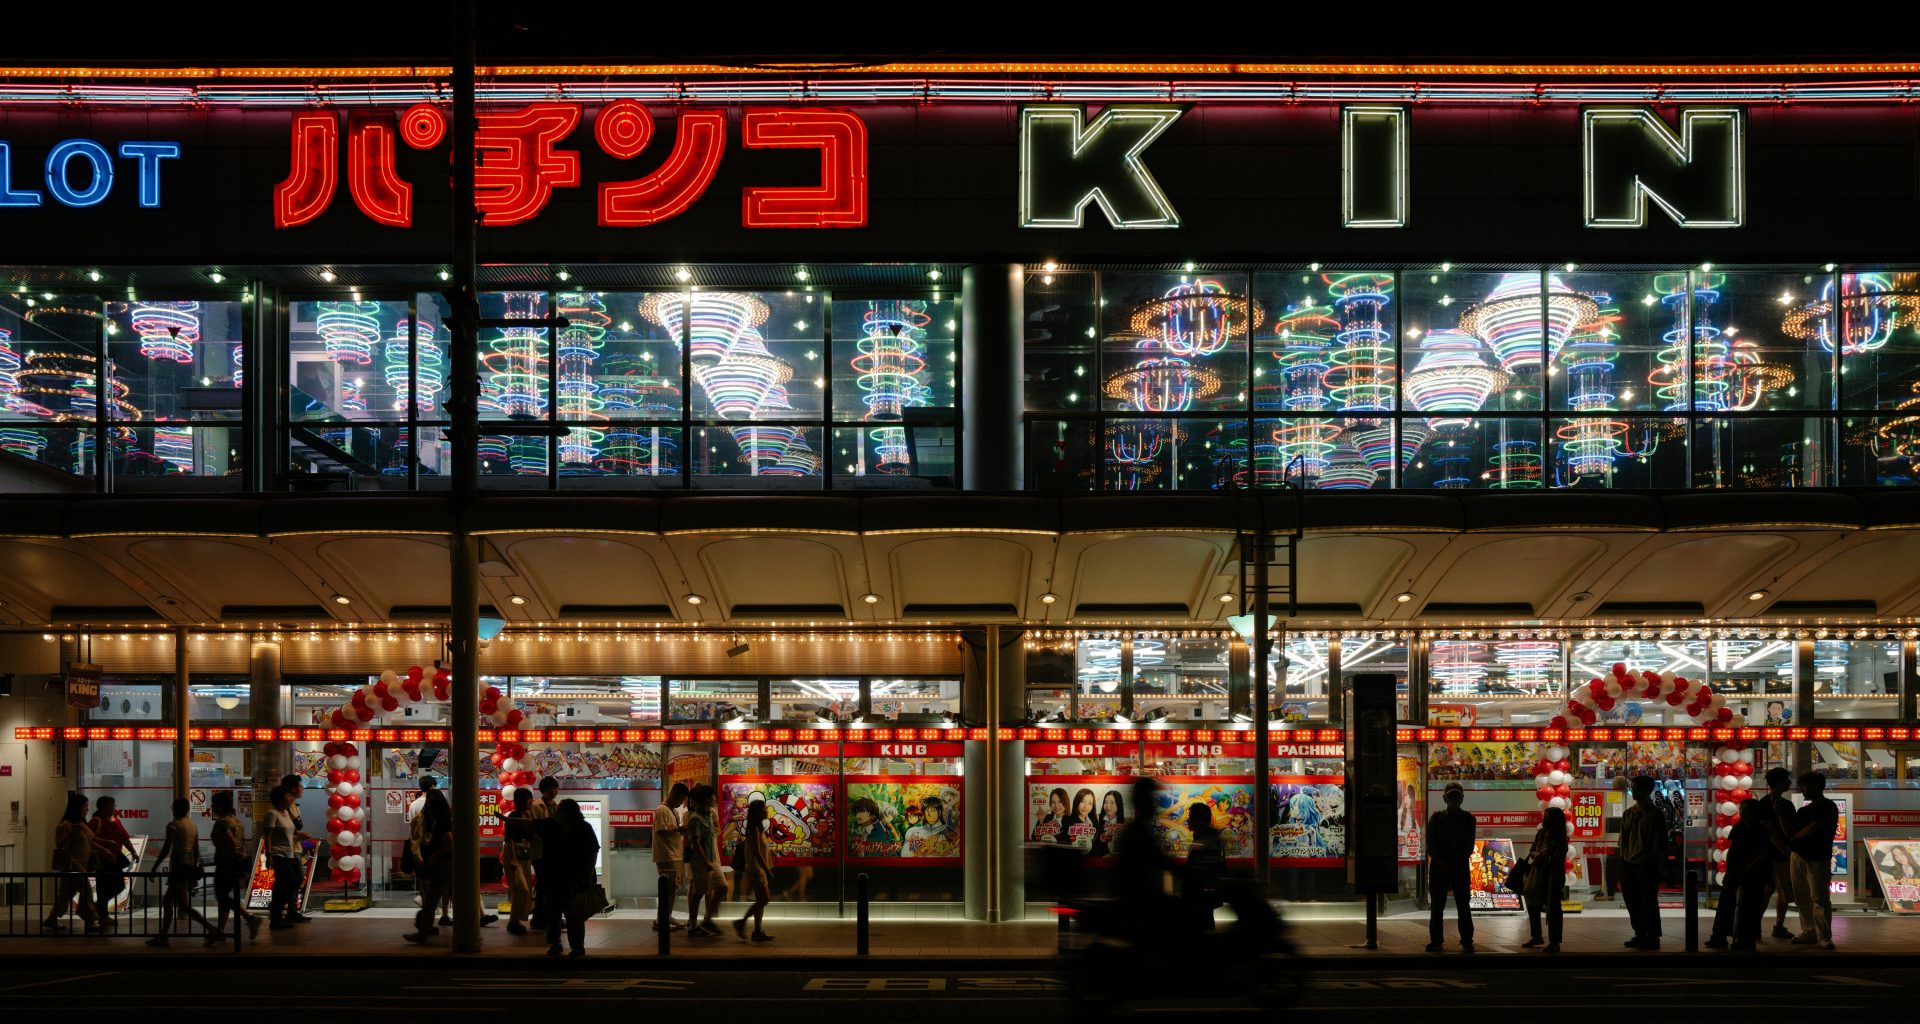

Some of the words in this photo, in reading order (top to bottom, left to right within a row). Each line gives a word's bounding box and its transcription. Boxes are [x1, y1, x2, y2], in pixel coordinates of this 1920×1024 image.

[273, 97, 869, 228] パチンコ
[0, 138, 181, 208] LOT
[69, 682, 98, 697] KING
[740, 744, 820, 755] PACHINKO
[880, 744, 928, 755] KING
[1057, 744, 1105, 755] SLOT
[1176, 744, 1223, 756] KING
[479, 794, 497, 804] 本日
[1579, 796, 1596, 805] 本日
[114, 809, 149, 818] KING
[1573, 805, 1602, 817] 10:00
[635, 814, 651, 823] SLOT
[1576, 817, 1599, 828] OPEN
[1583, 847, 1615, 855] KING
[1829, 882, 1847, 893] NG
